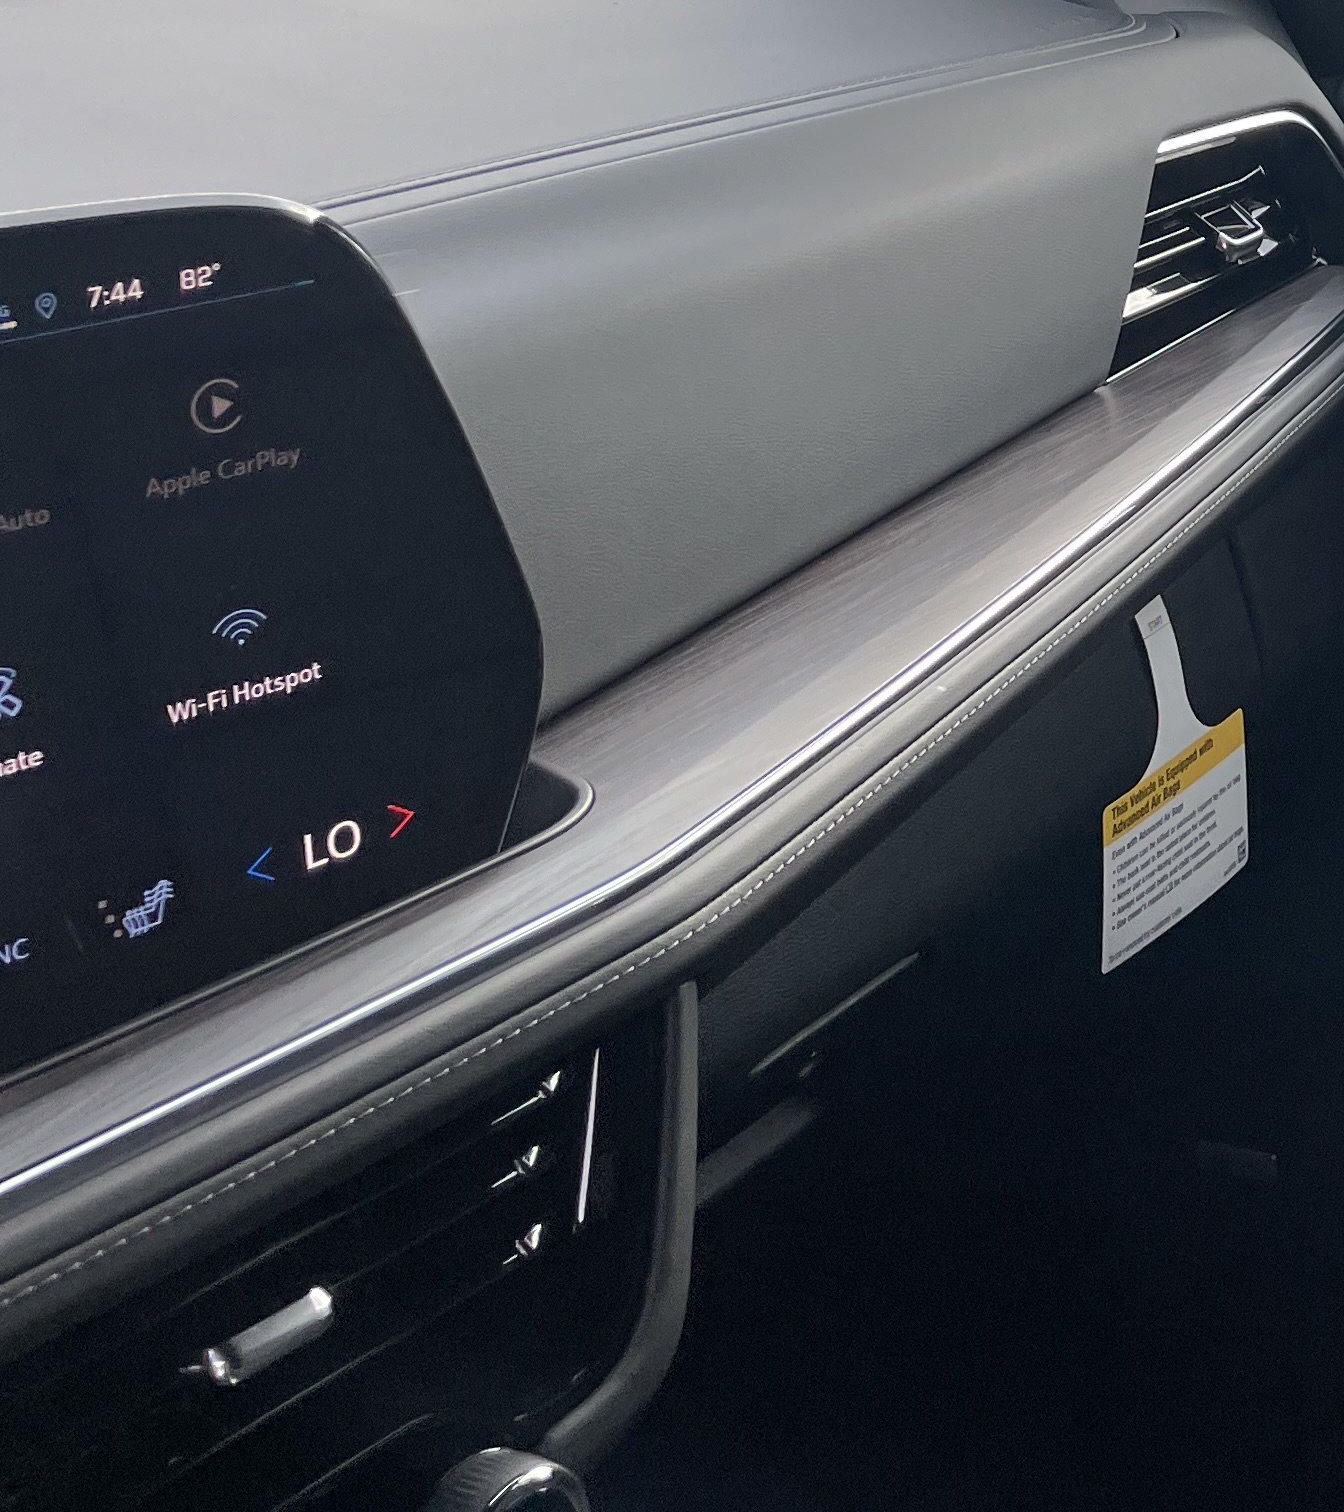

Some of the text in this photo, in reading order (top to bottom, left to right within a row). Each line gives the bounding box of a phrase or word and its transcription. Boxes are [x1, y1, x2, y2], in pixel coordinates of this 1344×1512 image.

[87, 278, 144, 308] 7:44
[145, 448, 301, 500] Apple CarPlay
[167, 662, 322, 725] Wi-Fi Hotspot
[1112, 738, 1214, 820] This Vehicle is Equipped with
[1112, 780, 1181, 838] Advanced Air Bags
[303, 819, 361, 870] LO
